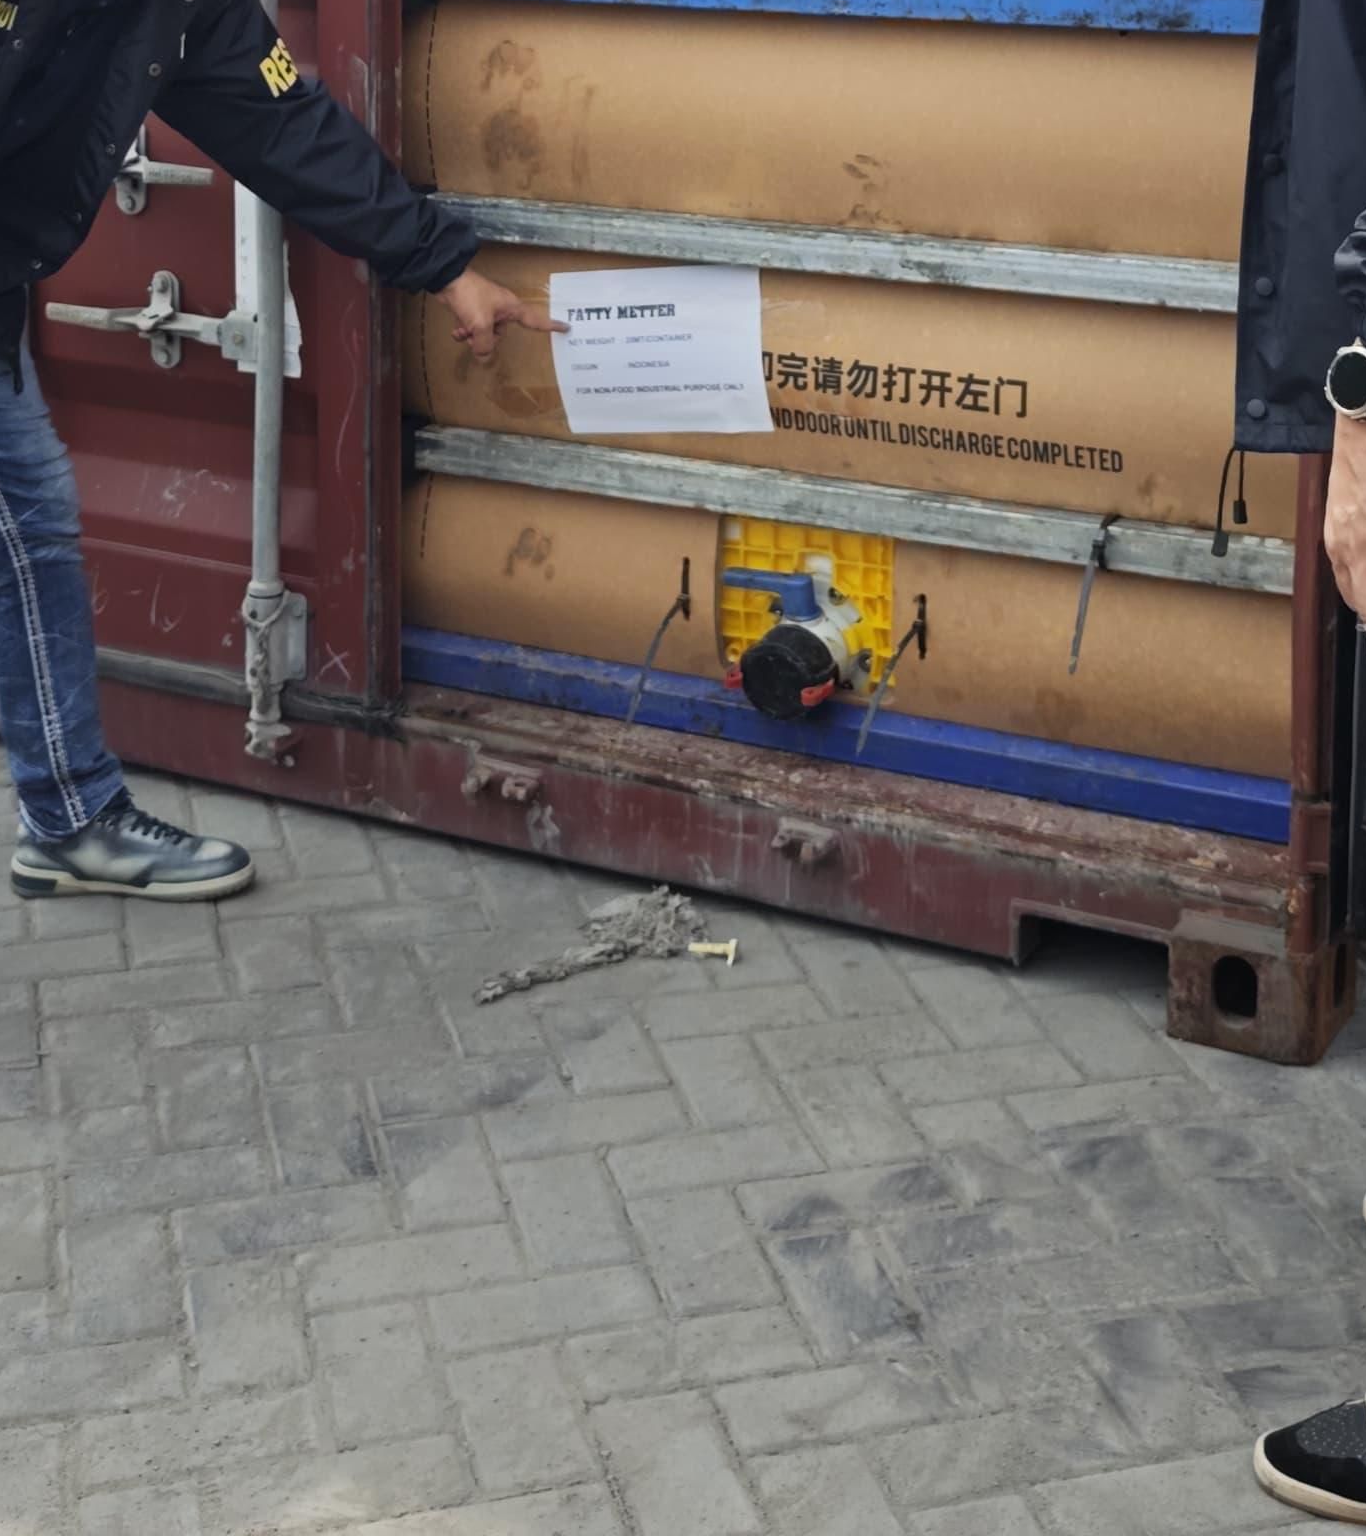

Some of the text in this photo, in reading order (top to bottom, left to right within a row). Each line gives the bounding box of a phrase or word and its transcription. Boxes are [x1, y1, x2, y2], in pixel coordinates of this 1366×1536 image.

[567, 303, 676, 322] FATTY METTER
[794, 409, 842, 437] DOOR
[843, 415, 897, 444] UNTIL
[899, 423, 1004, 460] DISCHARGE
[1007, 437, 1123, 473] COMPLETED
